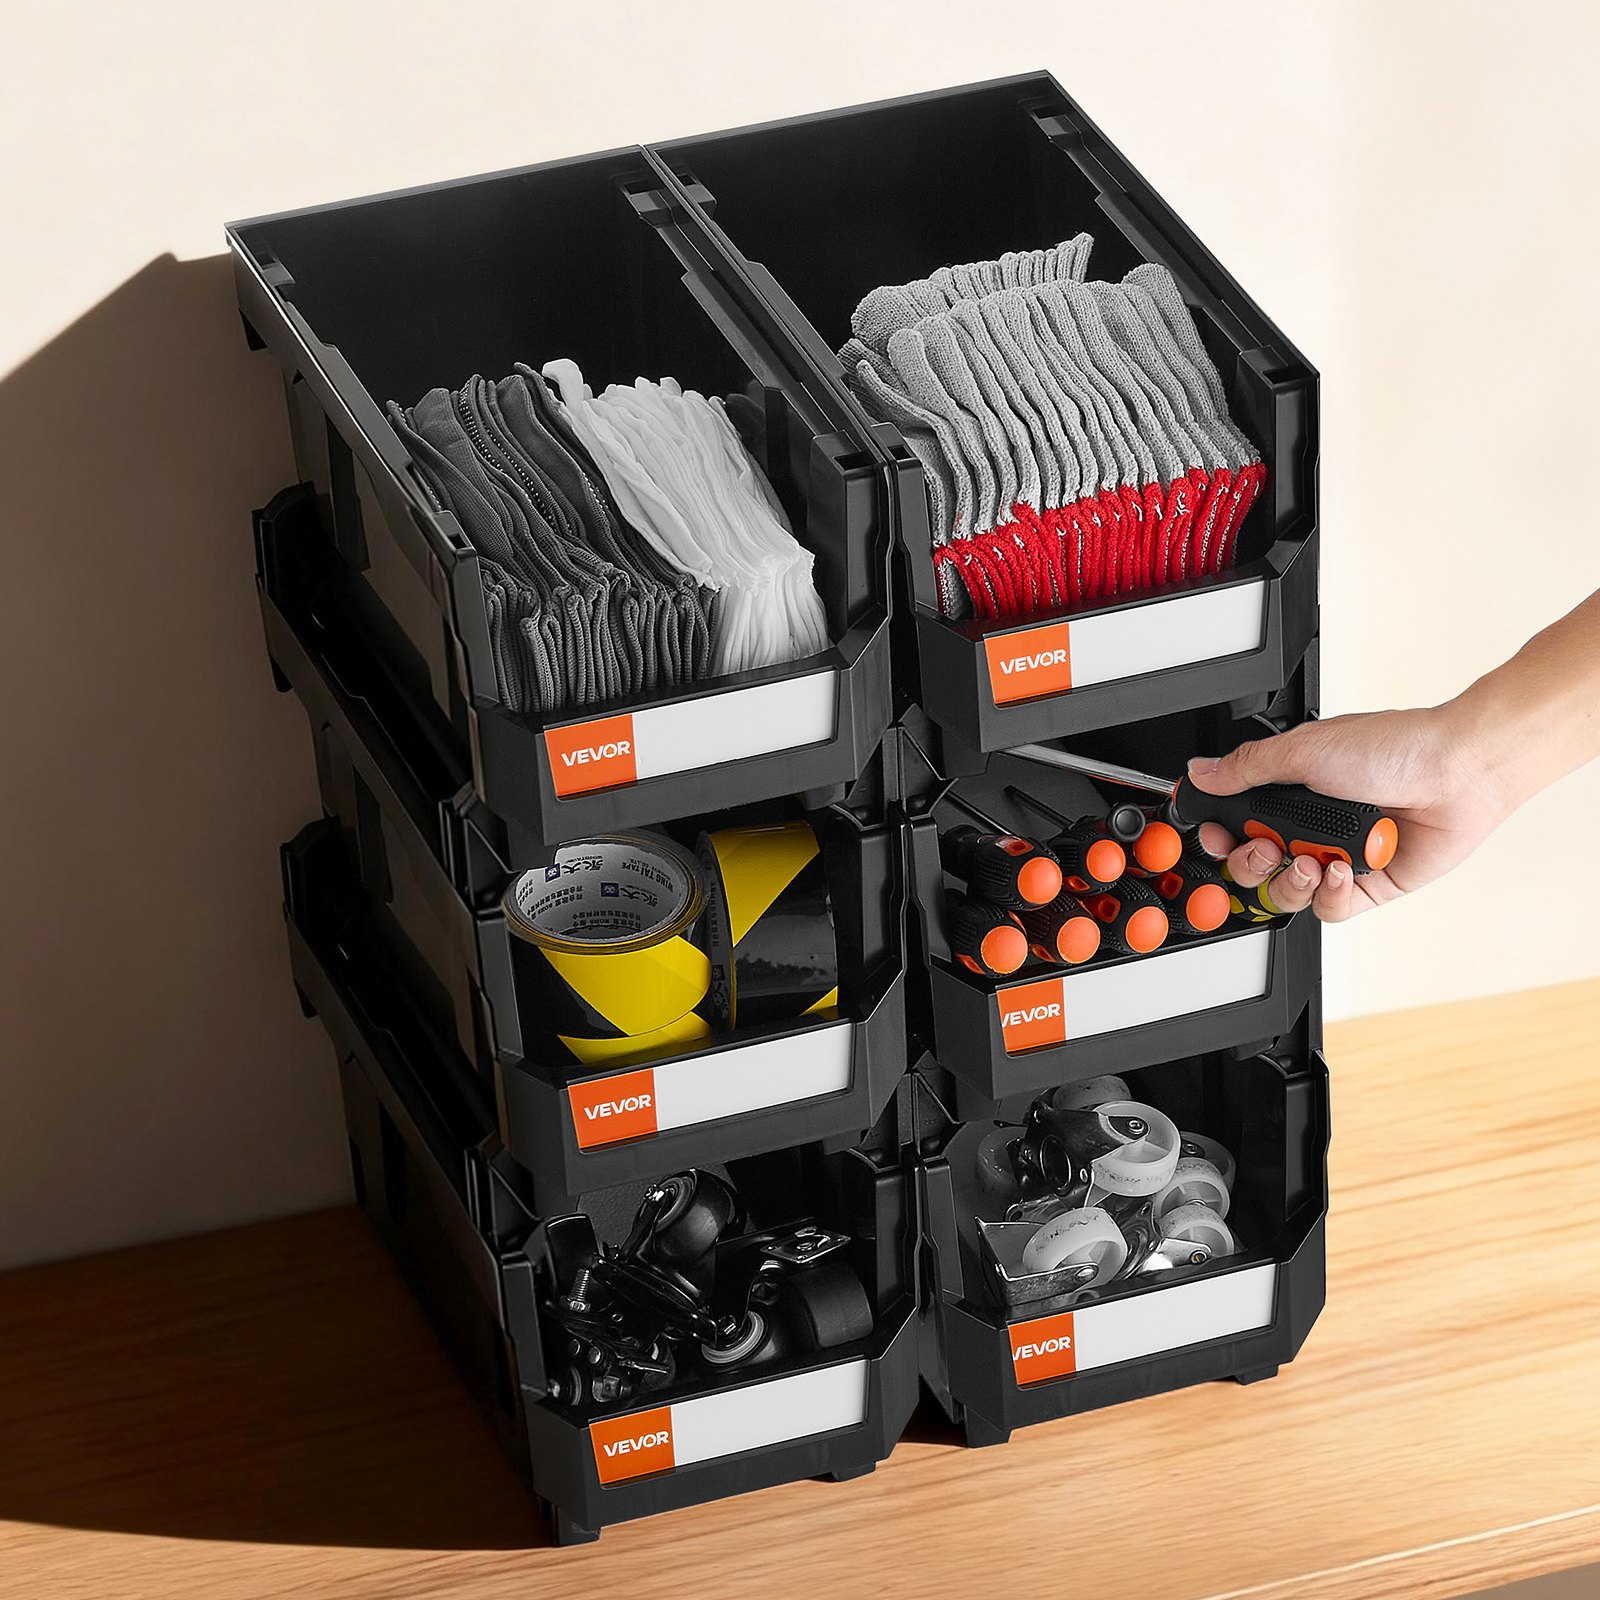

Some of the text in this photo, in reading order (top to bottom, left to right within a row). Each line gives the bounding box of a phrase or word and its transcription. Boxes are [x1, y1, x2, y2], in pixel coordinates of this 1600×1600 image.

[1000, 649, 1067, 675] VEVOR
[561, 740, 631, 767] VEVOR
[621, 862, 640, 872] TAPE
[640, 867, 654, 880] TAI
[584, 1094, 652, 1120] VEVOR
[603, 1431, 669, 1457] VEVOR
